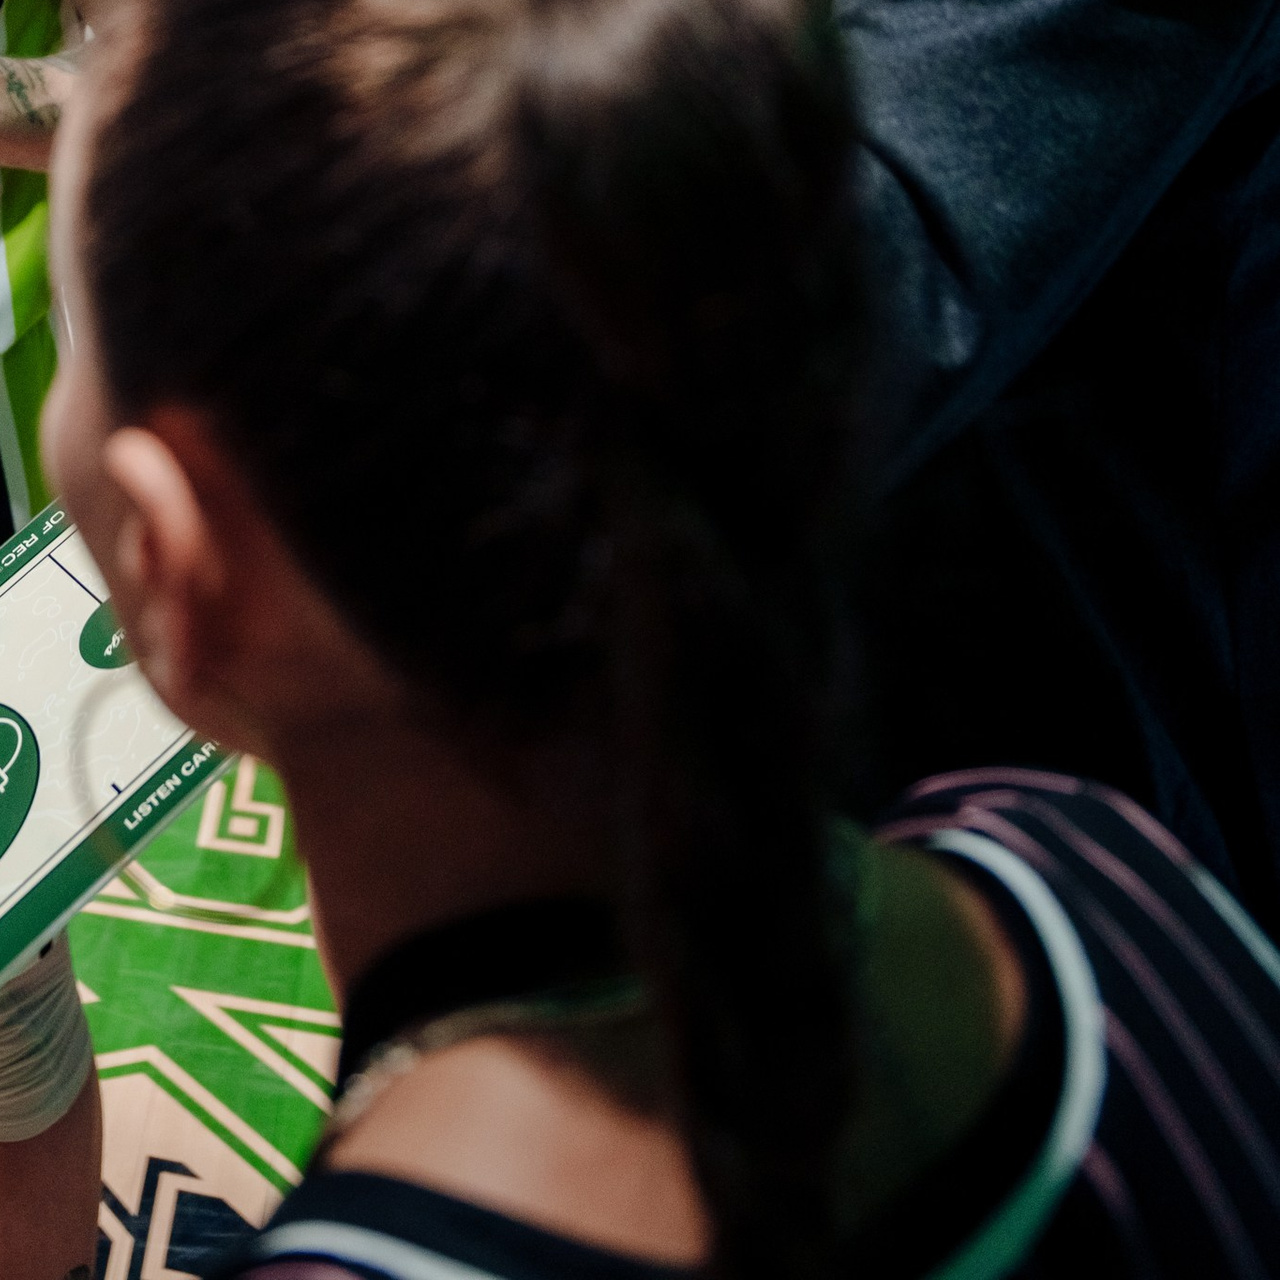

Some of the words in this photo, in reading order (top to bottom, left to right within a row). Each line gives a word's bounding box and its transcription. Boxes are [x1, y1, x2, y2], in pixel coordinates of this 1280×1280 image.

[42, 509, 66, 536] OF
[1, 532, 40, 567] REC
[123, 773, 183, 831] LISTEN
[180, 739, 220, 777] CAR
